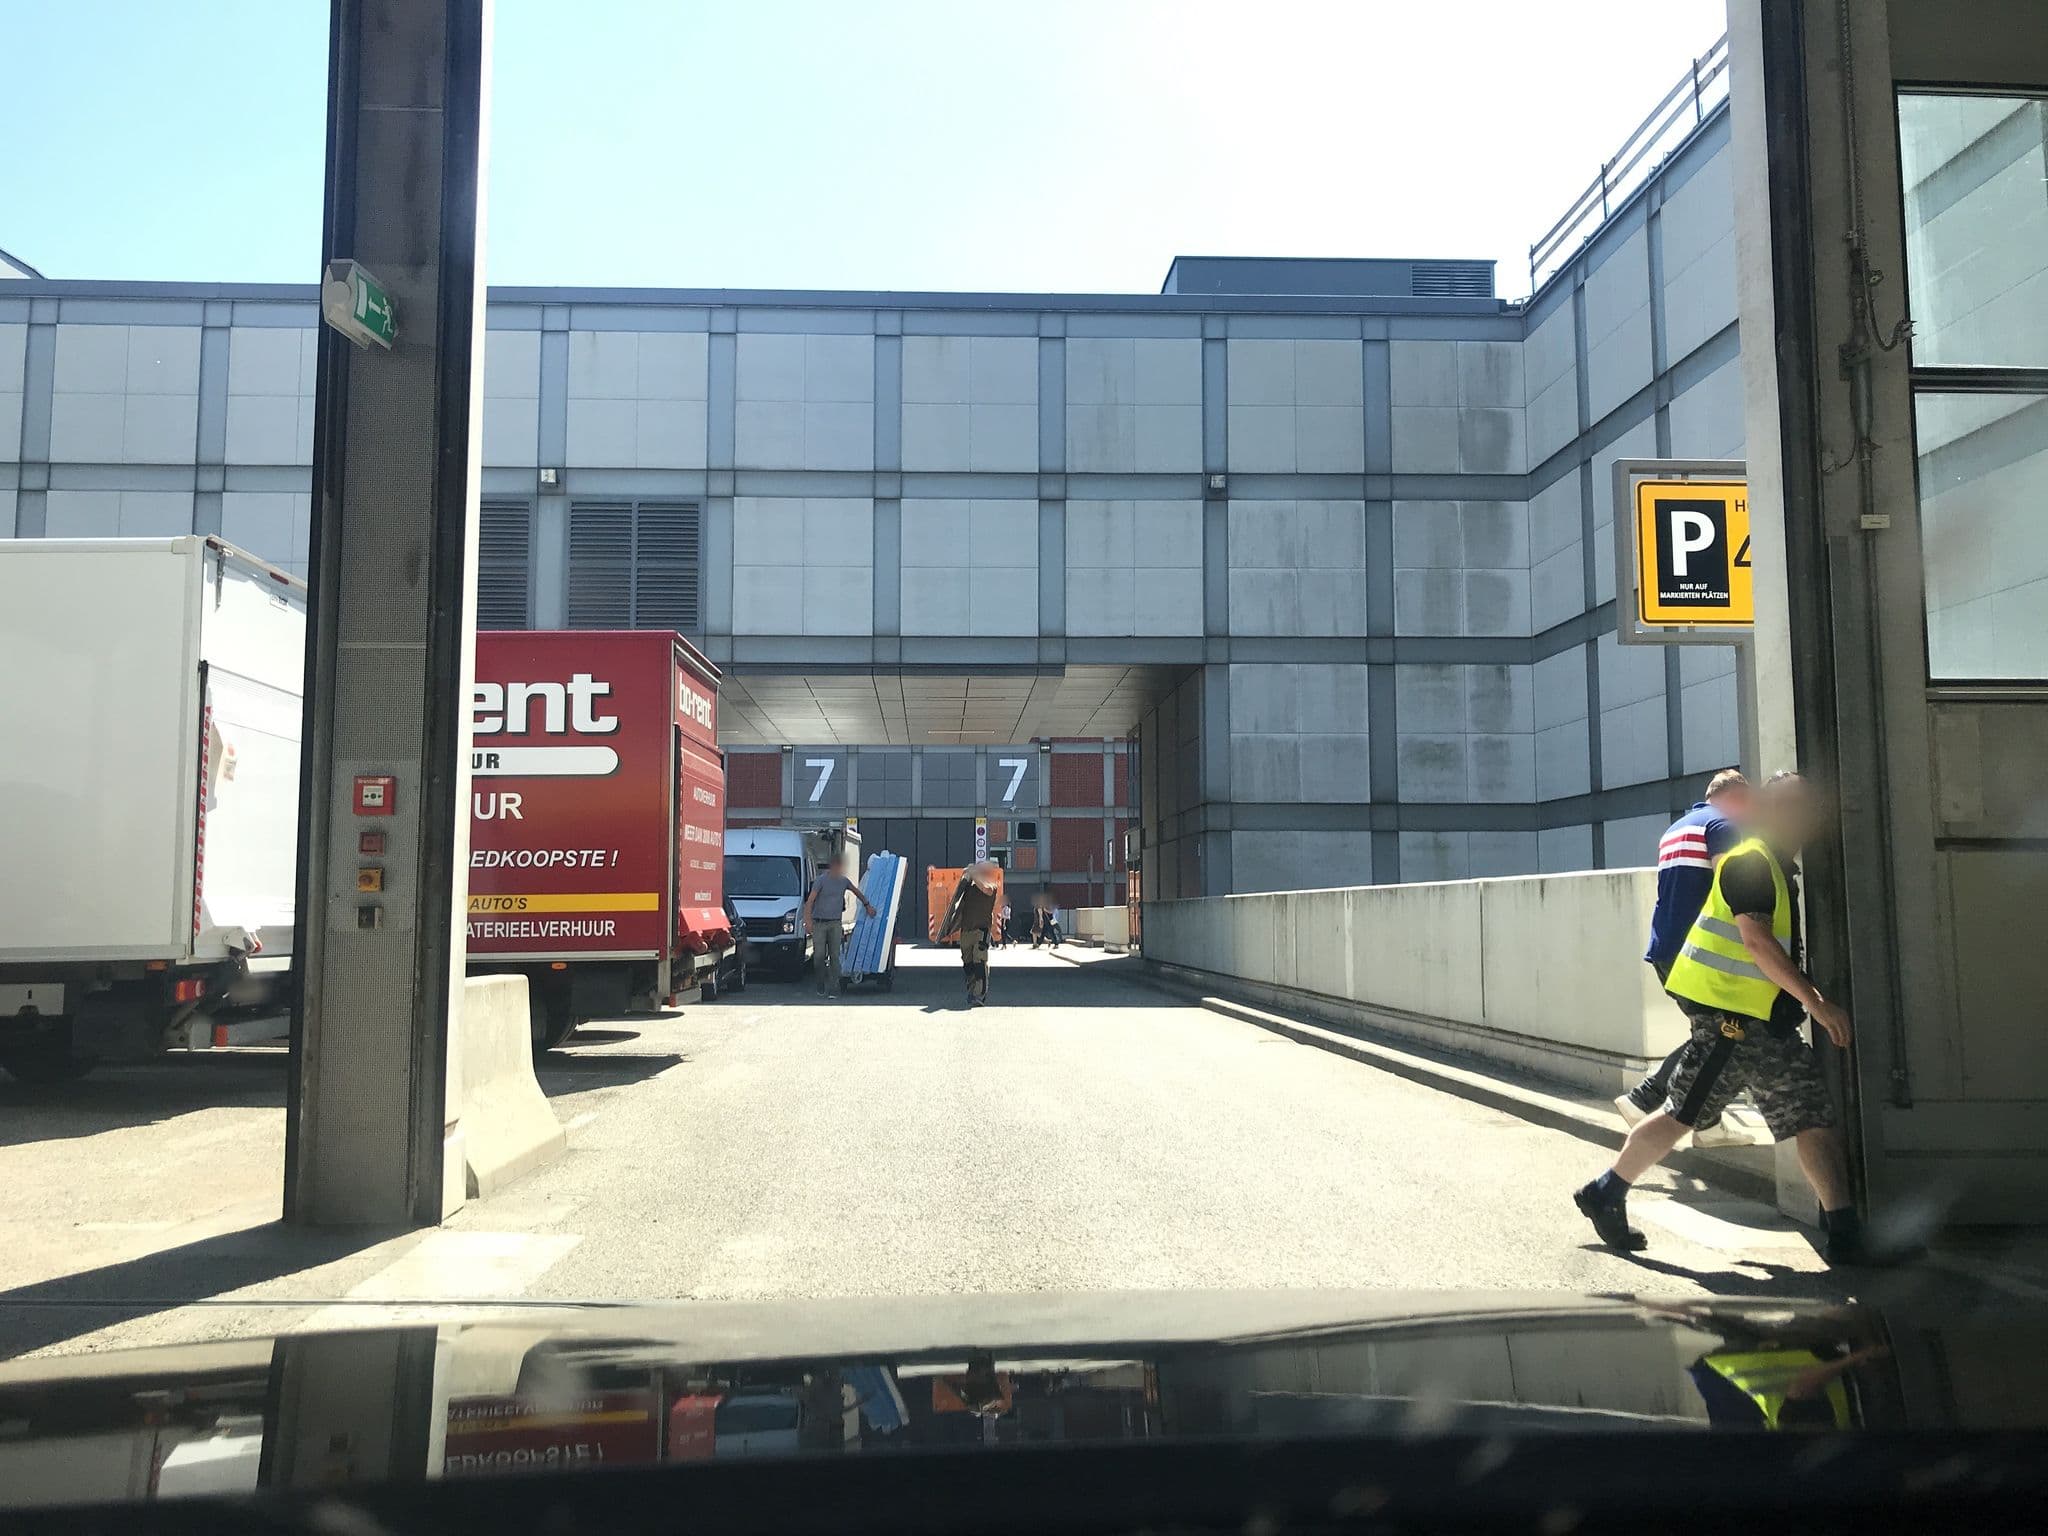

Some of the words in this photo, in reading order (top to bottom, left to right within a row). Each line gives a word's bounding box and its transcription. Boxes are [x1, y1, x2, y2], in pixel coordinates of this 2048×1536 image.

[1670, 510, 1716, 576] P
[1660, 591, 1700, 599] MARKIERTEN
[1701, 590, 1729, 599] PLÄTZEN
[679, 671, 712, 730] bo-rent
[805, 758, 835, 802] 7
[999, 758, 1028, 802] 7
[474, 792, 524, 820] UR
[470, 849, 606, 868] EDKOOPSTE
[469, 897, 528, 910] AUTO'S
[466, 920, 616, 938] ATERIEELVERHUUR
